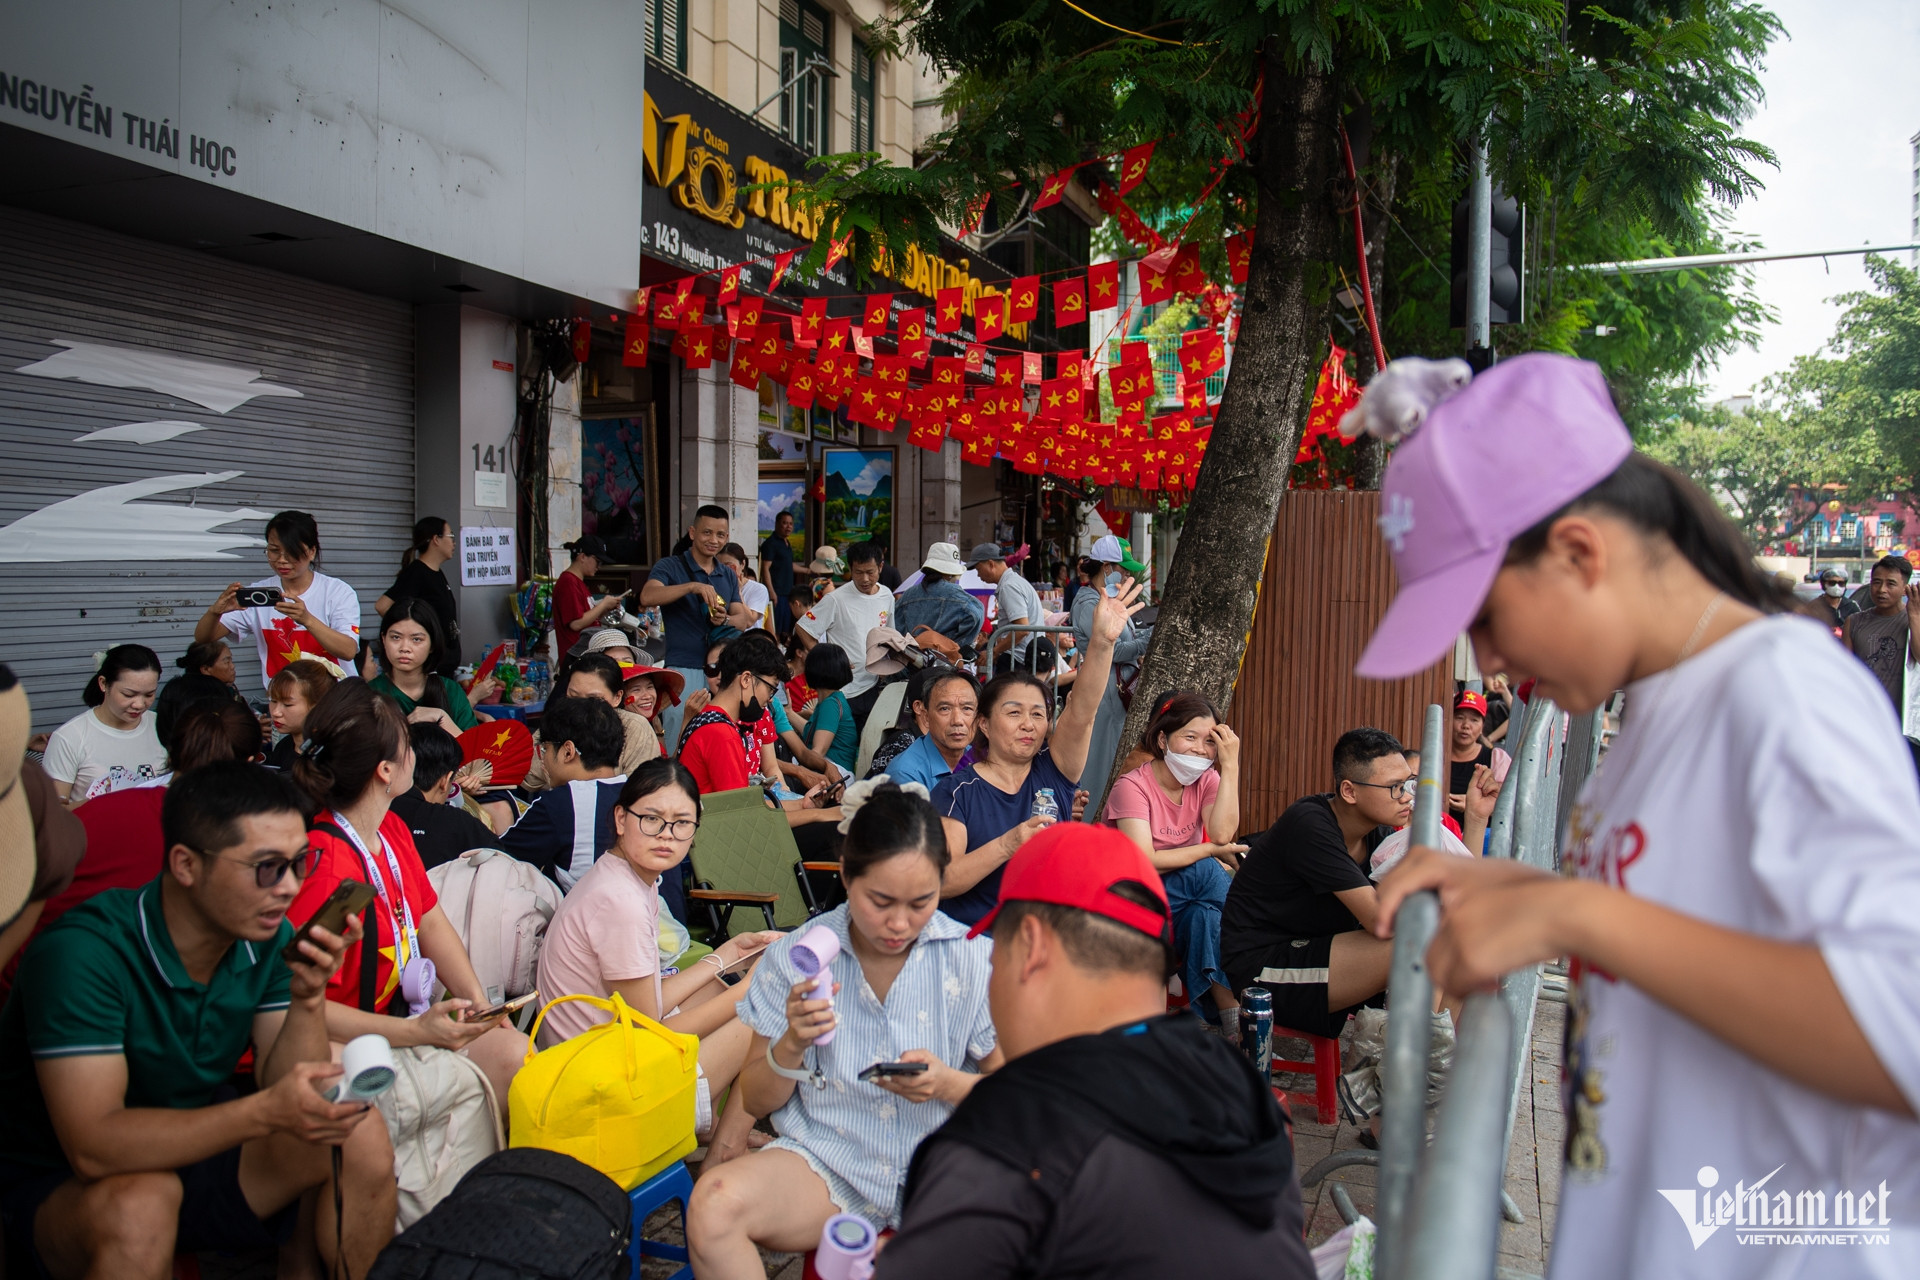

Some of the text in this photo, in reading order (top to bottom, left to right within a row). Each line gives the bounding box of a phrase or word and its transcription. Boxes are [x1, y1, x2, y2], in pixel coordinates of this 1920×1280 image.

[0, 71, 237, 178] NGUYỄN THÁI HỌC
[703, 127, 729, 155] Quan
[653, 221, 680, 255] 143
[682, 241, 715, 269] Nguyễn
[472, 442, 505, 474] 141
[465, 535, 510, 547] BÁNH BAO 20K
[466, 552, 476, 562] GIA
[500, 565, 512, 576] 20K
